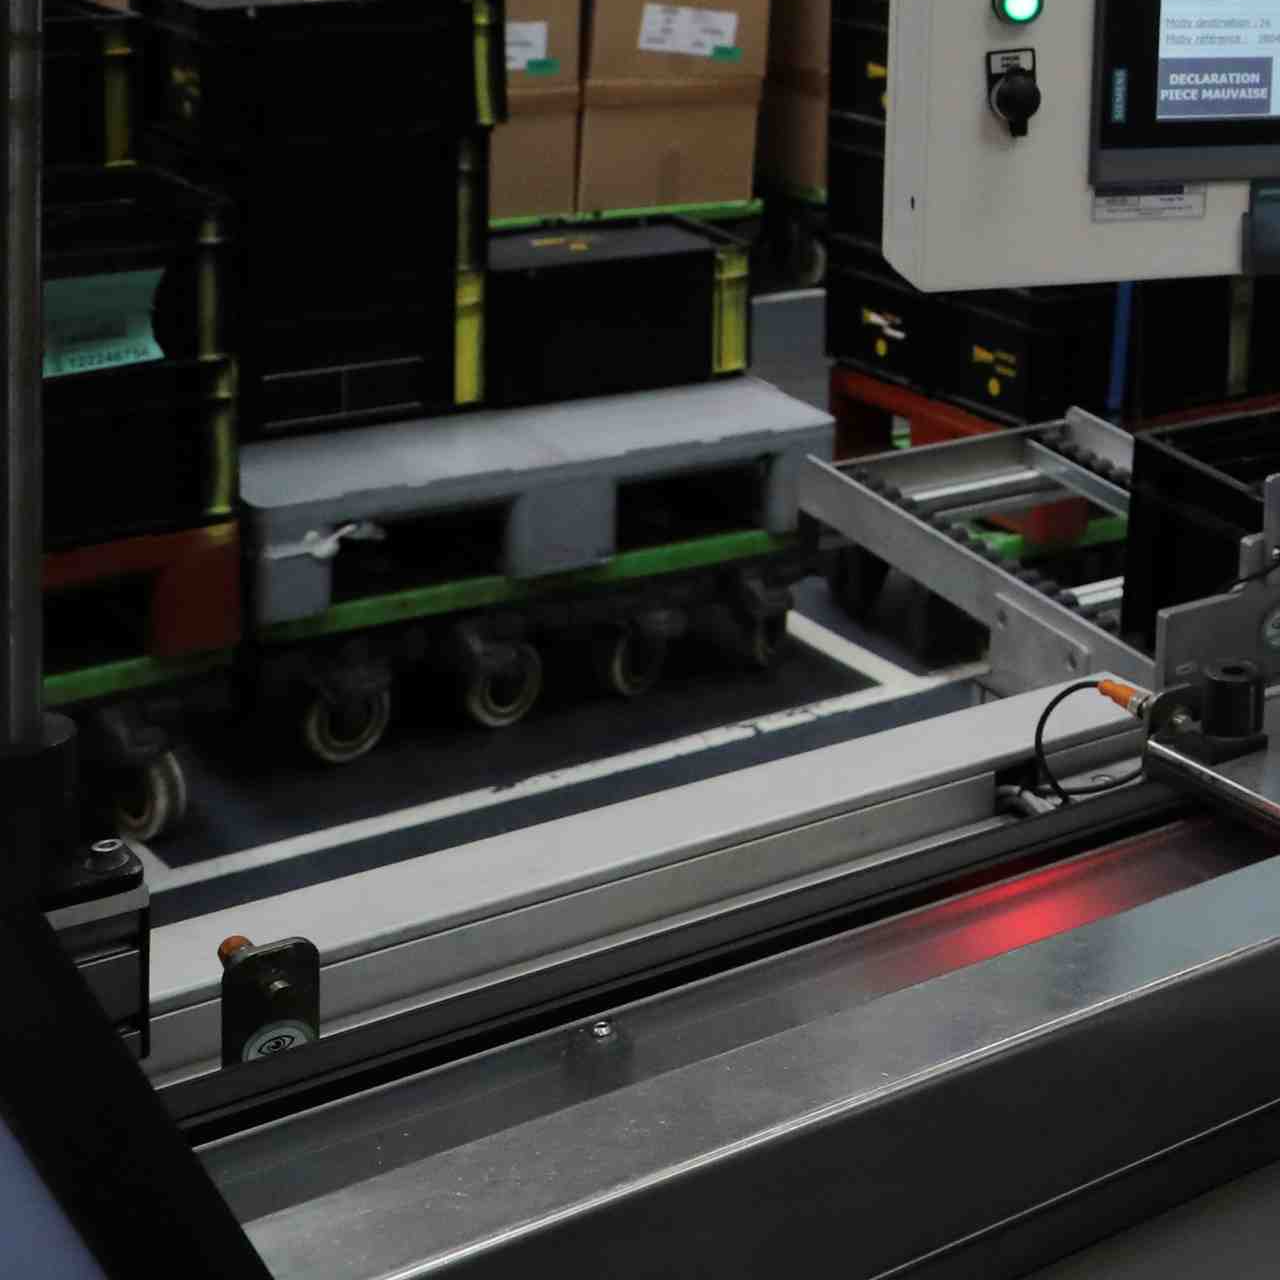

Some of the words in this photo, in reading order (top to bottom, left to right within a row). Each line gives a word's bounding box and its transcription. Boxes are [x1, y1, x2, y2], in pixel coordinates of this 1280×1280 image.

[1169, 71, 1261, 86] DECLARATION
[1160, 89, 1198, 102] PIECE
[1201, 88, 1269, 101] MAUVAISE
